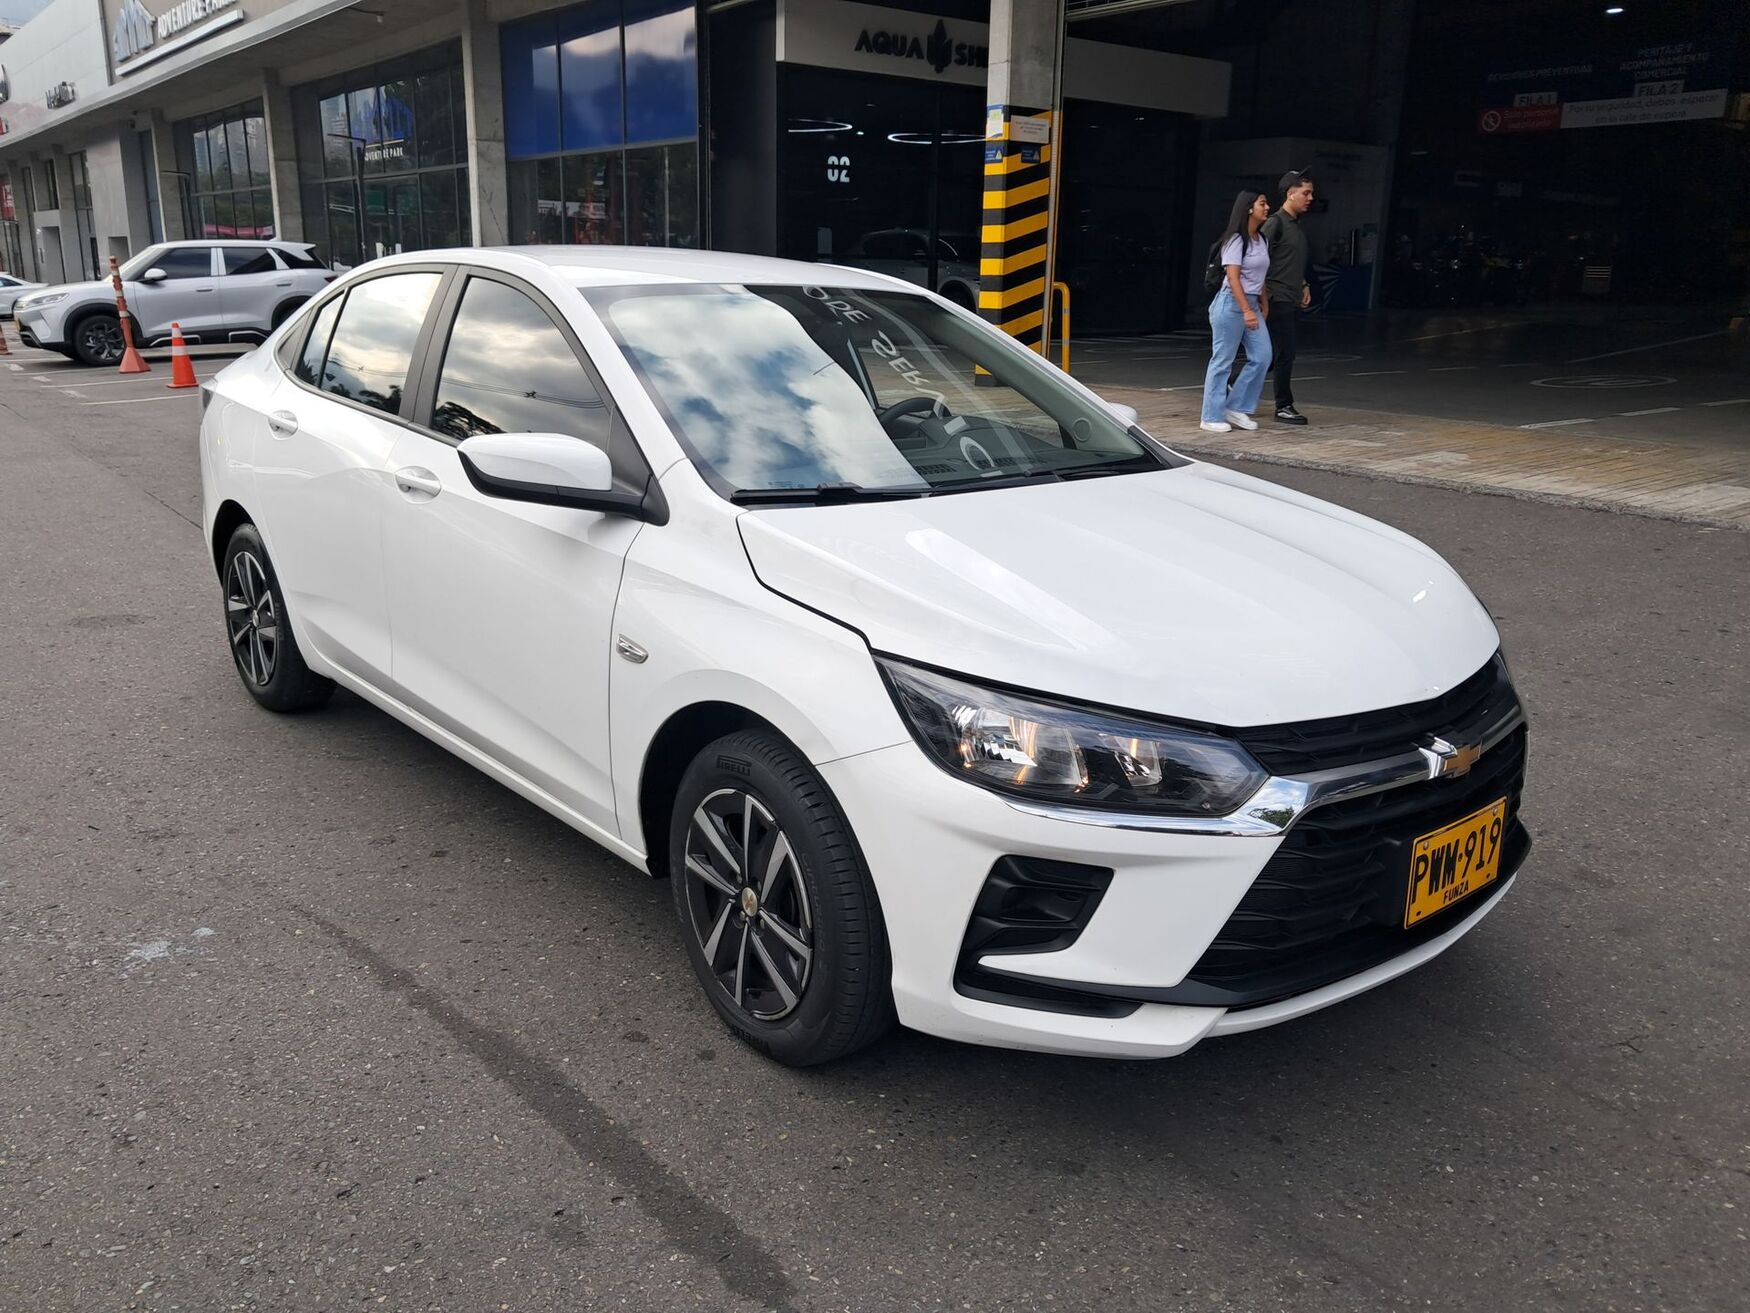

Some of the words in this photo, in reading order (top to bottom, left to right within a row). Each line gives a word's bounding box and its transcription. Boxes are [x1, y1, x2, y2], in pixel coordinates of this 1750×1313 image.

[157, 0, 207, 39] ADVENTURE
[854, 30, 924, 60] AQUA
[1519, 95, 1544, 106] FILA
[1640, 84, 1666, 96] FILA
[1668, 83, 1679, 94] 2
[390, 146, 403, 158] PARK
[827, 155, 850, 183] 02
[716, 754, 752, 777] PIRELLI
[1443, 880, 1469, 904] FUNZA
